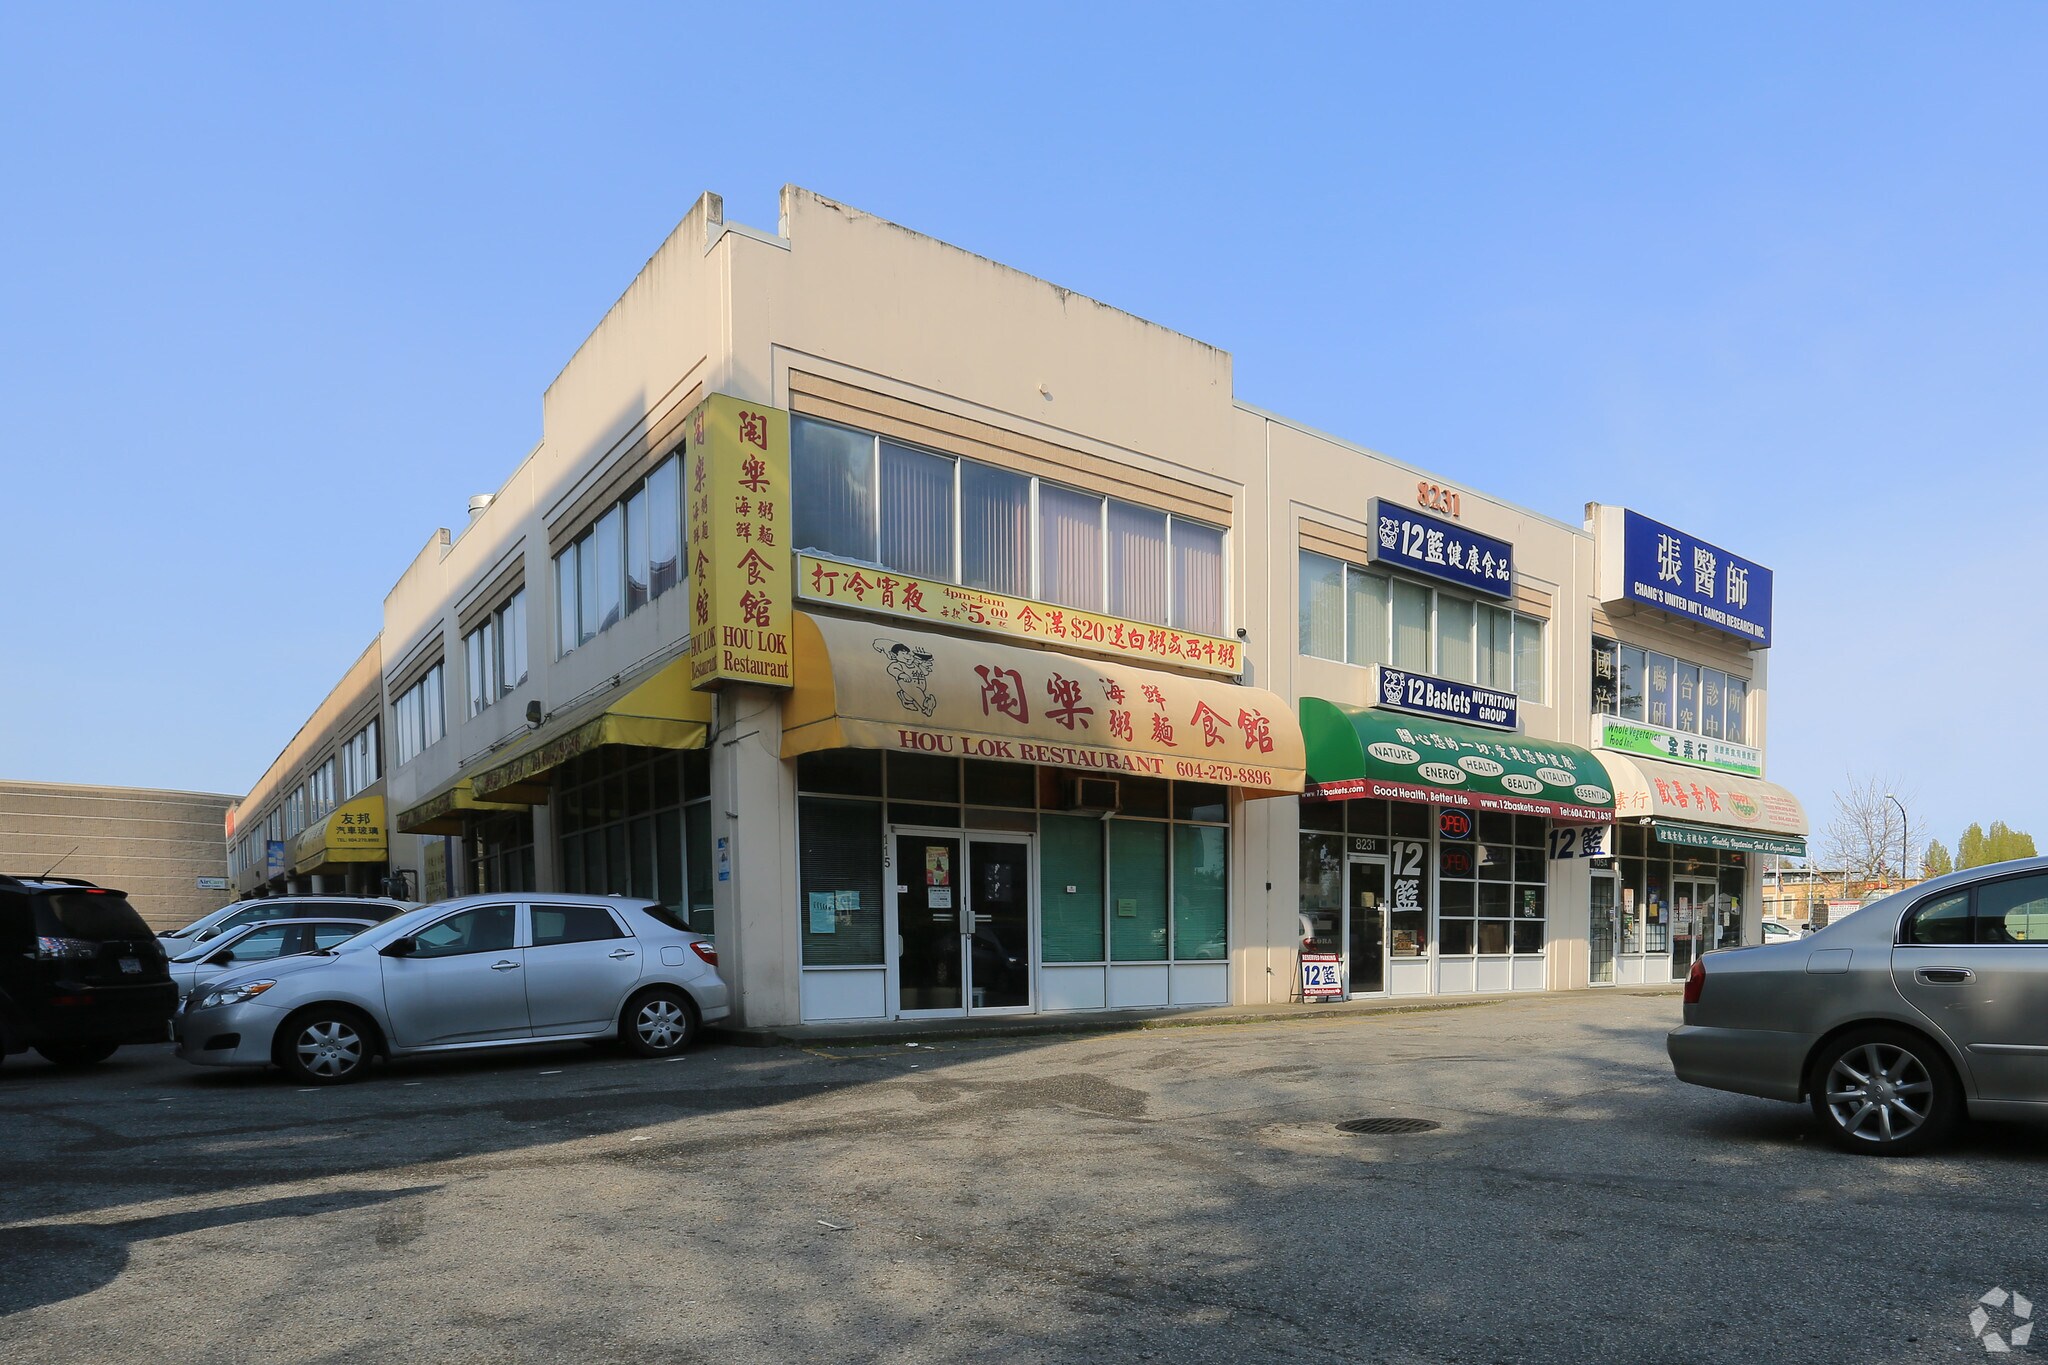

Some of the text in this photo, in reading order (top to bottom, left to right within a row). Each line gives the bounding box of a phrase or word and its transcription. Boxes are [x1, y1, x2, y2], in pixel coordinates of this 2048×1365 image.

[1417, 481, 1461, 517] 8231
[1657, 533, 1749, 610] 張醫師
[737, 548, 774, 627] 食館
[812, 563, 928, 613] 打冷宵夜
[943, 587, 1005, 607] 4pm-4am
[1634, 581, 1766, 639] CHANG'S UNITED INT'L CANCER RESEARCH INC.
[723, 626, 787, 655] HOU LOK
[723, 650, 789, 679] Restaurant
[1099, 678, 1166, 711] 海鮮
[1407, 678, 1471, 714] 12 Baskets
[1472, 690, 1516, 711] NUTRITION
[1479, 706, 1507, 723] GROUP
[1109, 709, 1178, 747] 粥麵
[1190, 700, 1273, 753] 食館
[1608, 721, 1662, 742] Whole Vegetarian
[1609, 734, 1634, 748] Food Inc.
[898, 730, 1272, 785] HOU LOK RESTAURANT 604-279-8896
[1373, 746, 1413, 761] NATURE
[1425, 766, 1460, 781] ENERGY
[1466, 760, 1499, 773] HEALTH
[1540, 770, 1573, 784] VITALITY
[1507, 778, 1538, 791] BEAUTY
[1576, 788, 1609, 800] ESSENTIAL
[1373, 785, 1398, 796] Good
[1399, 788, 1429, 802] Health,
[1430, 791, 1454, 803] Better
[1454, 796, 1471, 806] Life.
[1480, 798, 1551, 814] www.12baskets.com
[341, 813, 370, 824] 友邦
[1440, 816, 1469, 833] OPEN
[1355, 838, 1376, 851] 8231
[1730, 838, 1753, 850] Vegetarian
[1753, 841, 1764, 850] Food
[1769, 843, 1785, 853] Organic
[1393, 842, 1423, 876] 12
